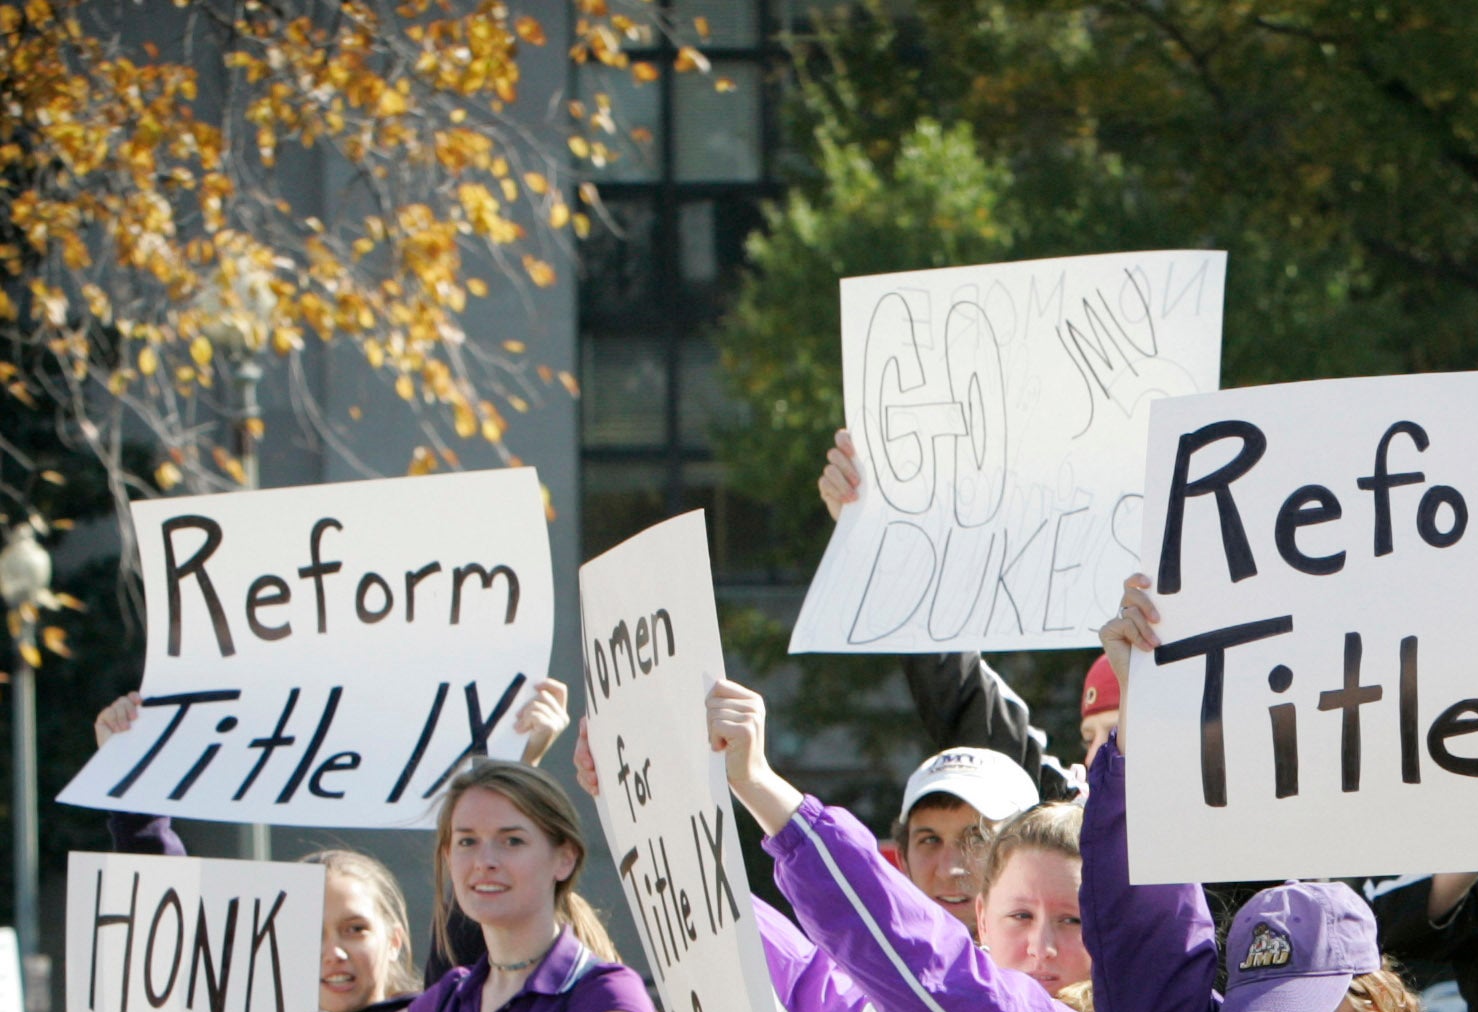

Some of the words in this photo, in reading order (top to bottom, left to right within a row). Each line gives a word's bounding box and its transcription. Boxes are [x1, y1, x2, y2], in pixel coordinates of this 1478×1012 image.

[862, 292, 1007, 528] GO
[1054, 267, 1159, 440] JMU
[161, 514, 521, 658] Reform
[107, 683, 362, 804] Title
[386, 672, 528, 804] IX
[616, 734, 652, 824] for
[619, 835, 697, 983] Title
[690, 804, 741, 936] IX
[1239, 950, 1290, 969] JMU
